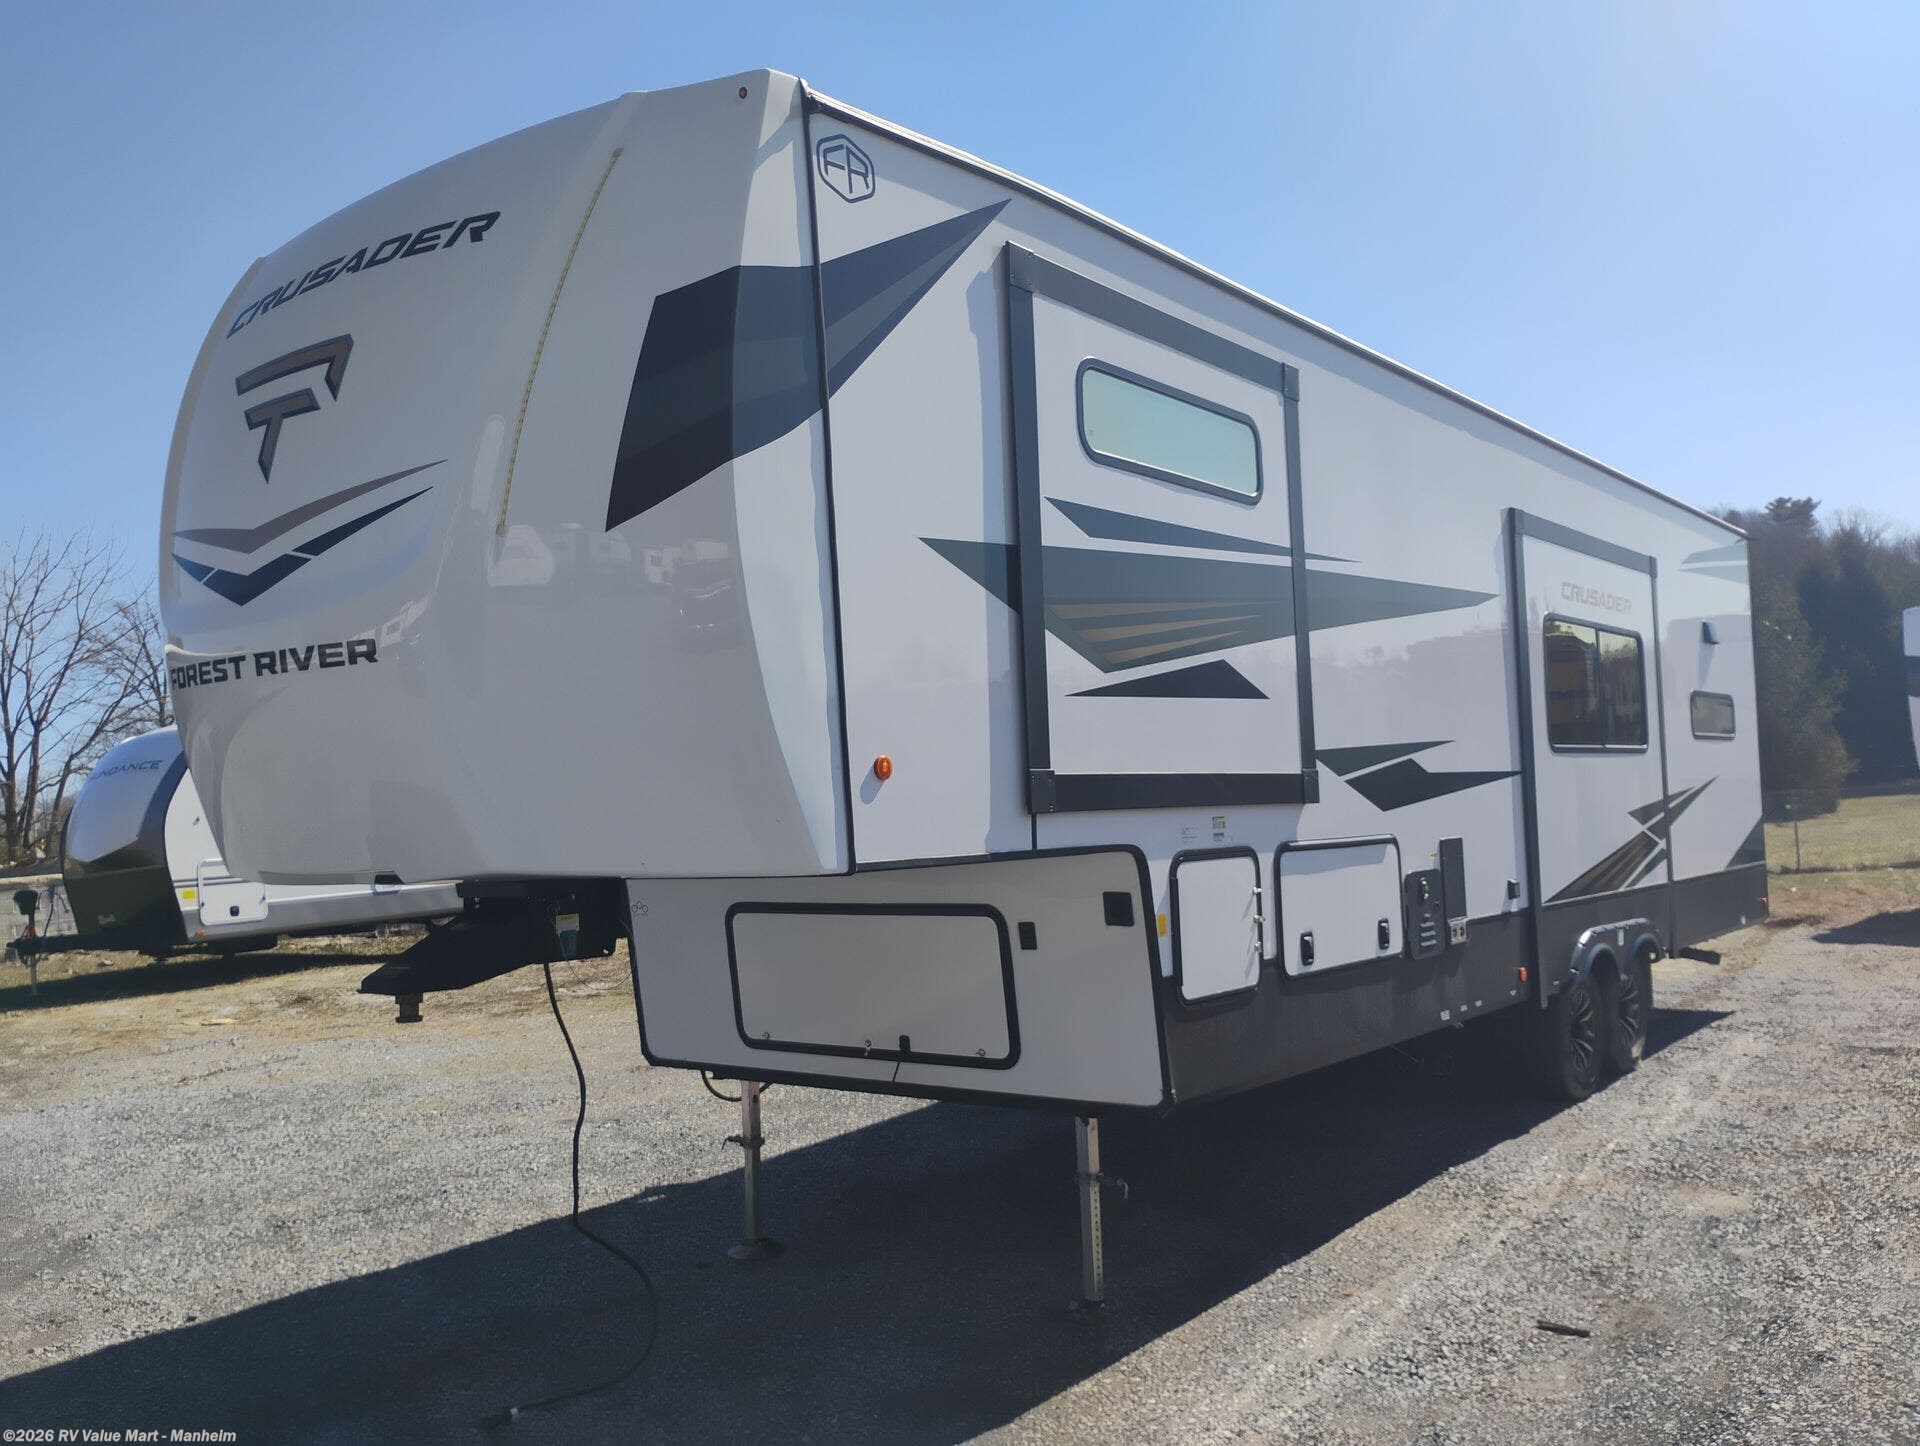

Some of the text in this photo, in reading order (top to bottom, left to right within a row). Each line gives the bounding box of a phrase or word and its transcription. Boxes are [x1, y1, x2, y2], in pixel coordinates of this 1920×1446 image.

[226, 210, 500, 339] CRUSADER
[1560, 581, 1632, 613] CRUSADER
[170, 638, 379, 689] FOREST RIVER
